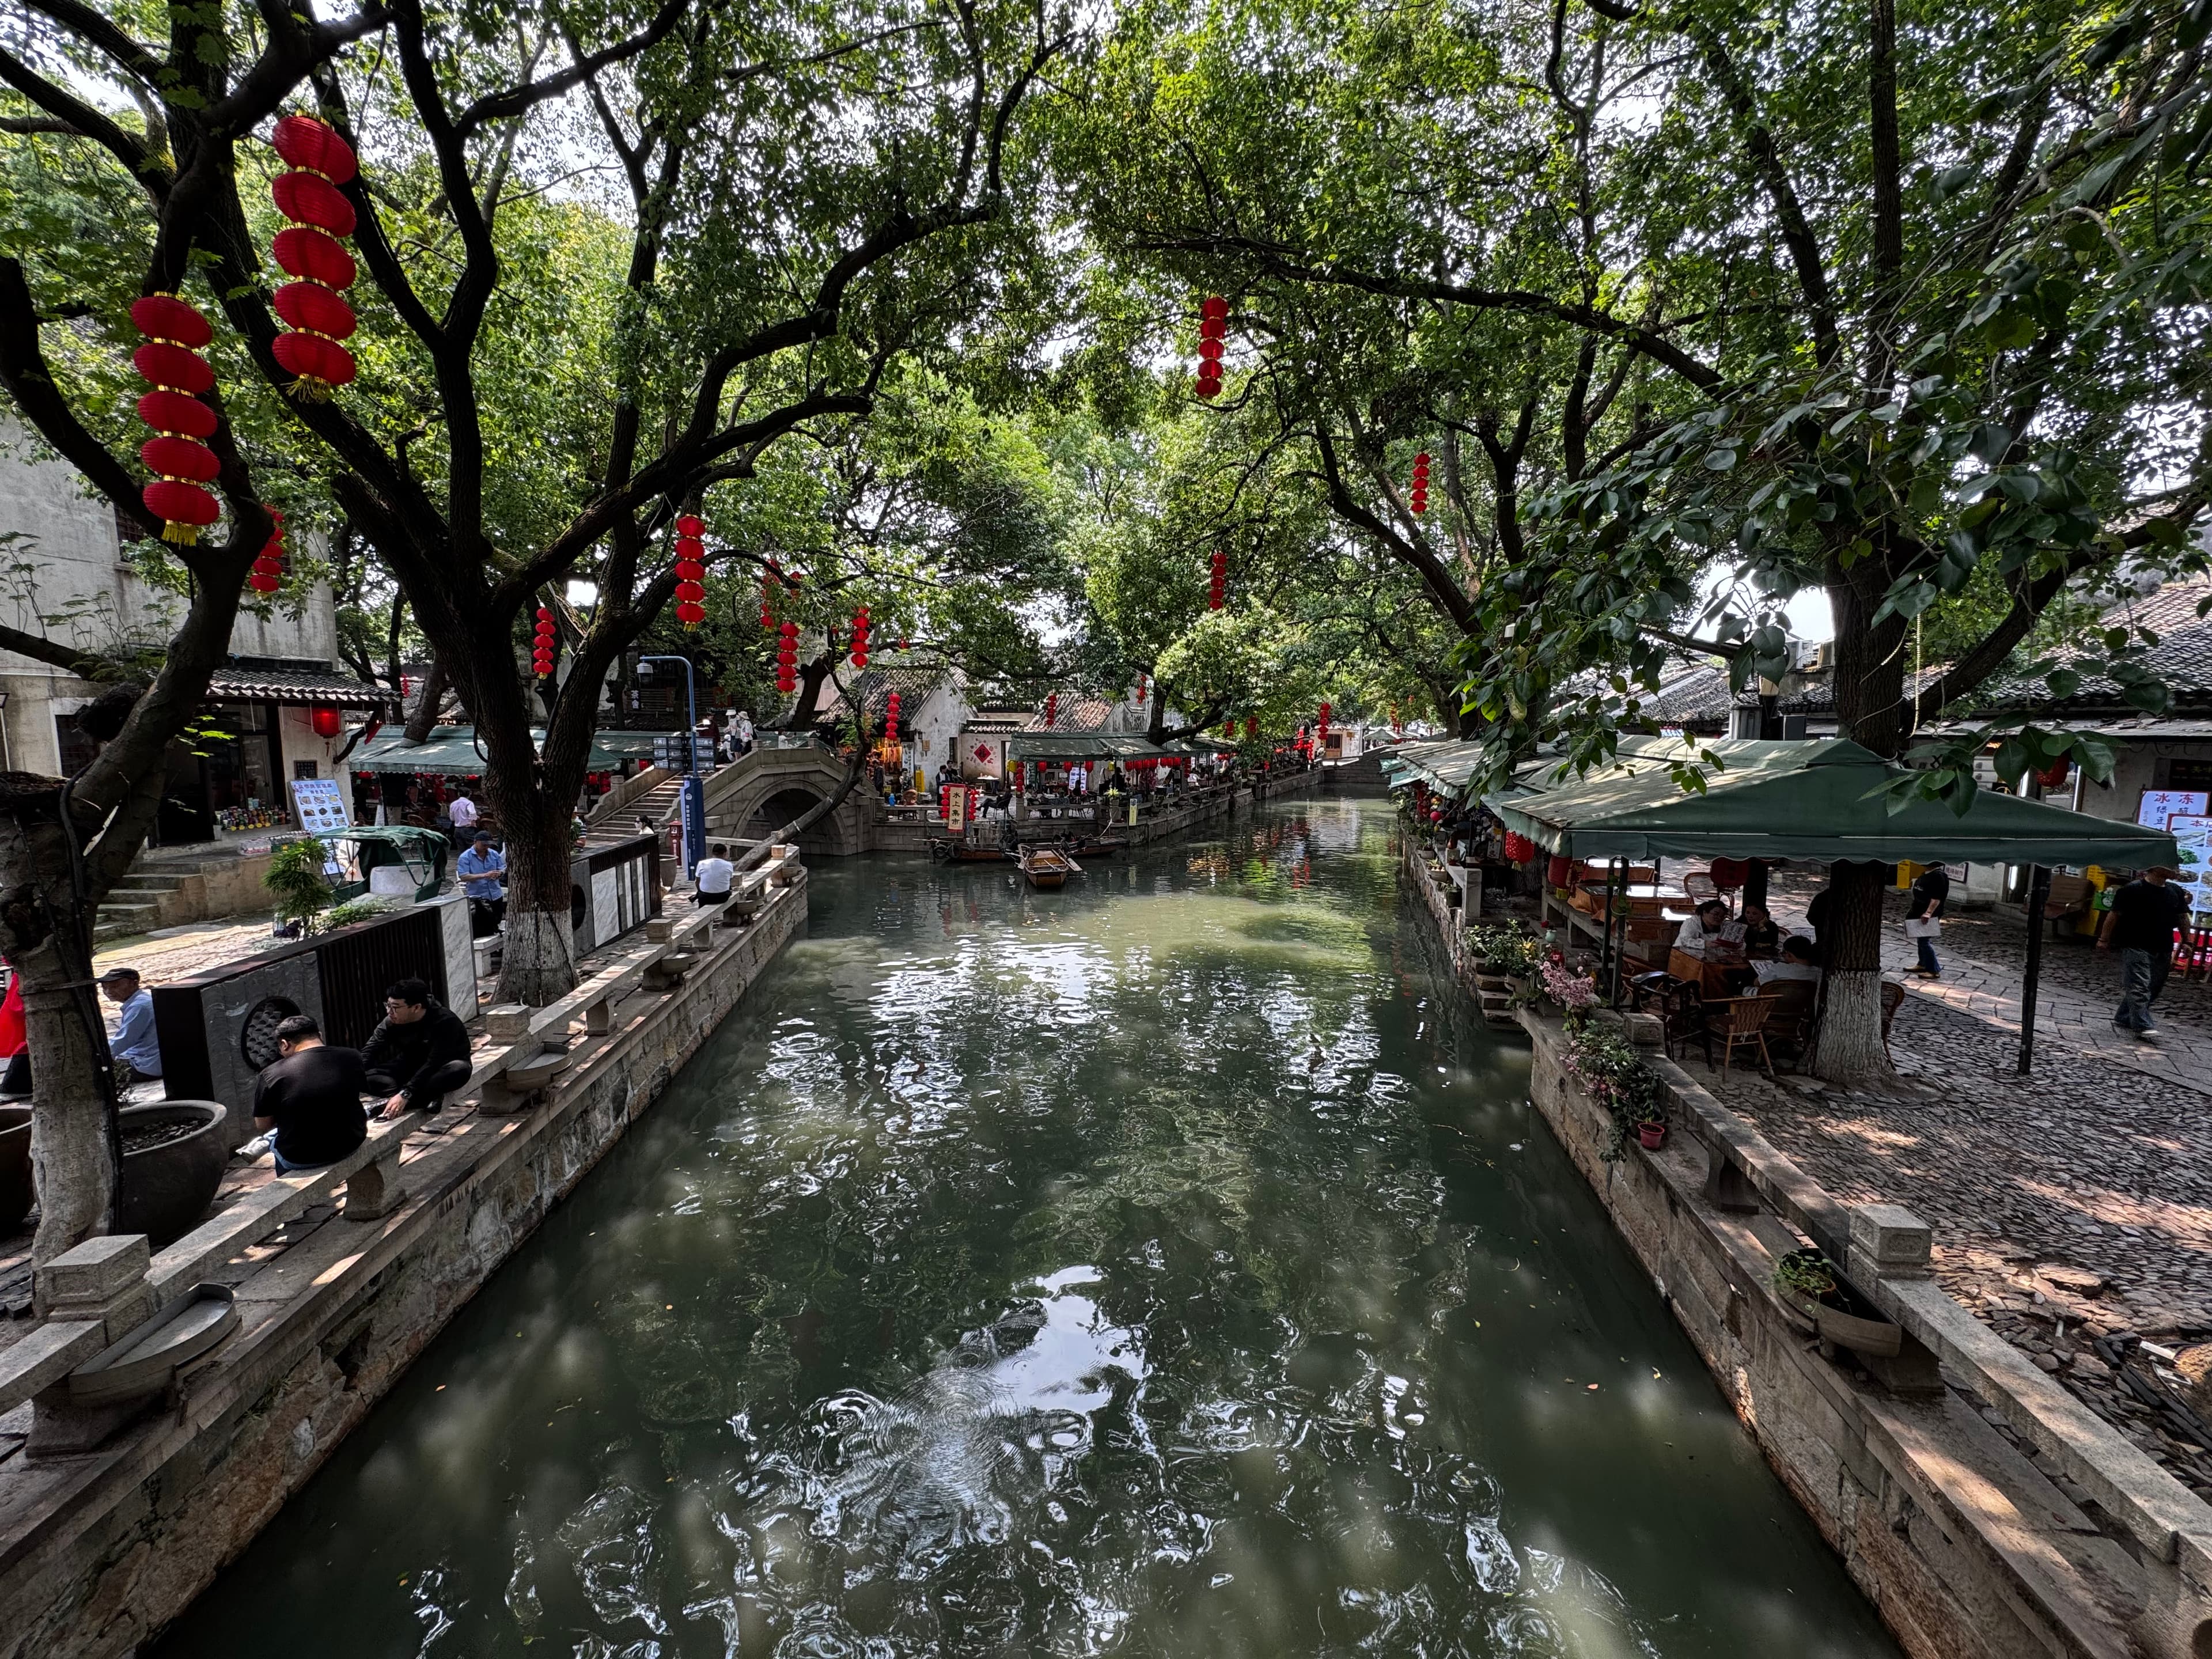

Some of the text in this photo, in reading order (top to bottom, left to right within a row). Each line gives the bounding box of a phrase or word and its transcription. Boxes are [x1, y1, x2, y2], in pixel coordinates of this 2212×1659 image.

[952, 792, 961, 825] 水上集市
[2154, 793, 2194, 805] 冰冻
[2153, 806, 2166, 828] 绿豆
